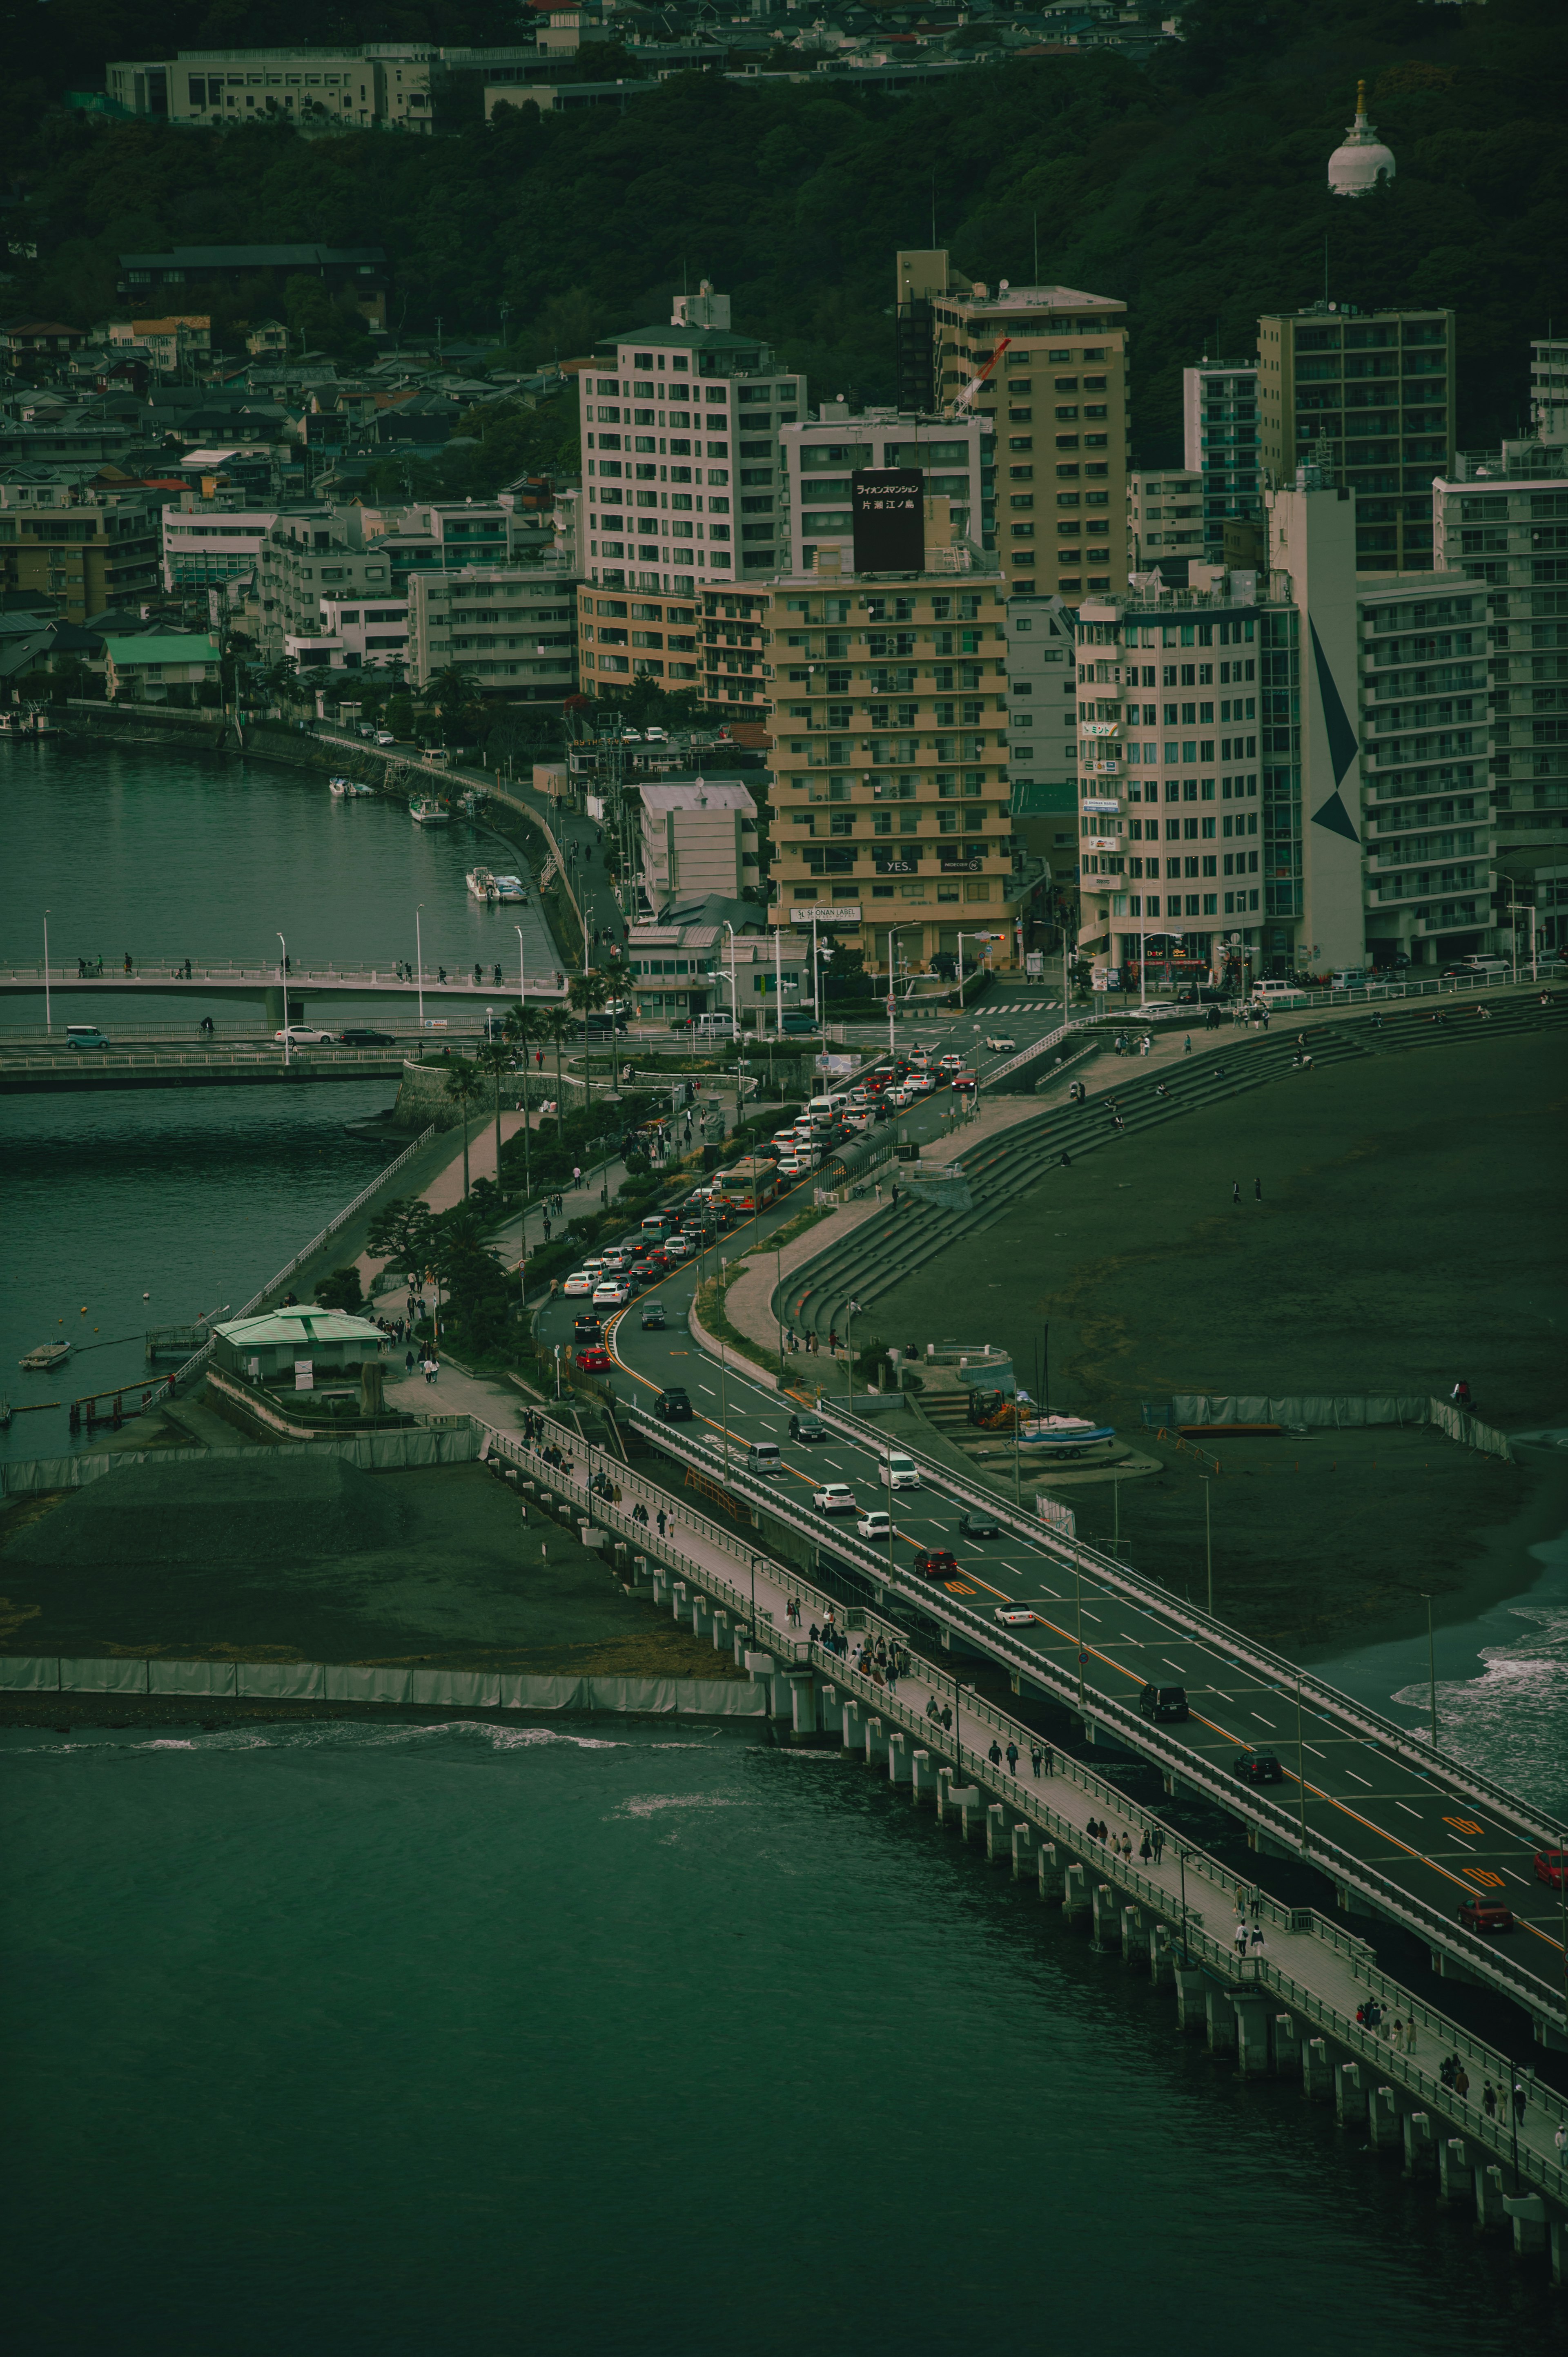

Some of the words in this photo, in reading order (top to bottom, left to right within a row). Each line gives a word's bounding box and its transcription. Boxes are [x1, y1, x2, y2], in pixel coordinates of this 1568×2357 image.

[857, 485, 919, 494] ライオンズマンション
[862, 499, 915, 510] 片瀬江ノ島
[887, 862, 911, 871] YES.
[944, 1581, 977, 1595] 40
[1442, 1817, 1485, 1835] 40
[1462, 1868, 1506, 1887] 40
